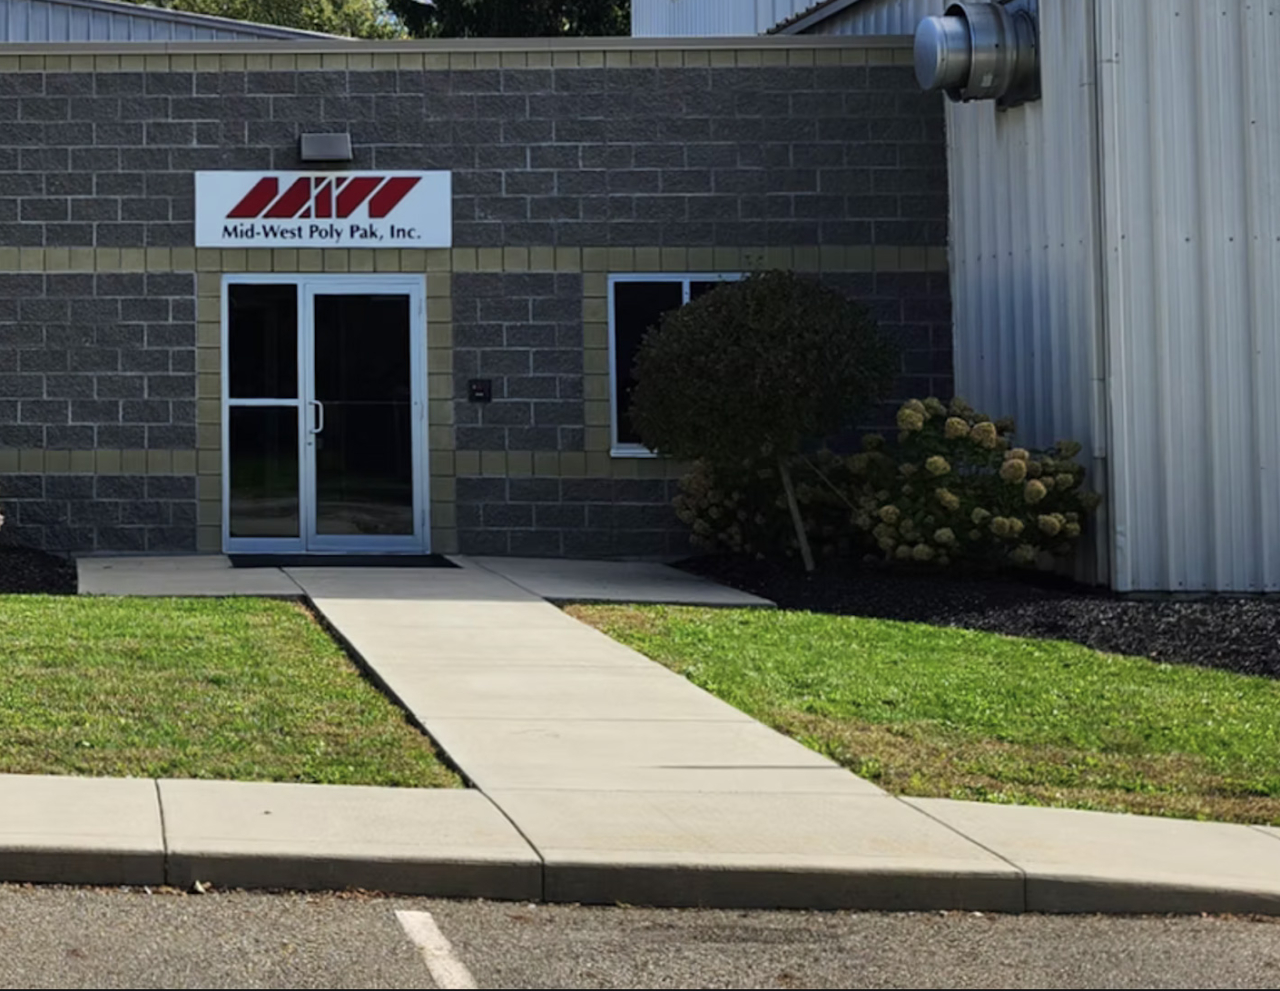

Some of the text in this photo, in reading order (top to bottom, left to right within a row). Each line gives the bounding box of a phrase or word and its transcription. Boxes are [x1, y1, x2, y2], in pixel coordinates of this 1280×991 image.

[222, 223, 421, 243] Mid-West Poly Pak, Inc.
